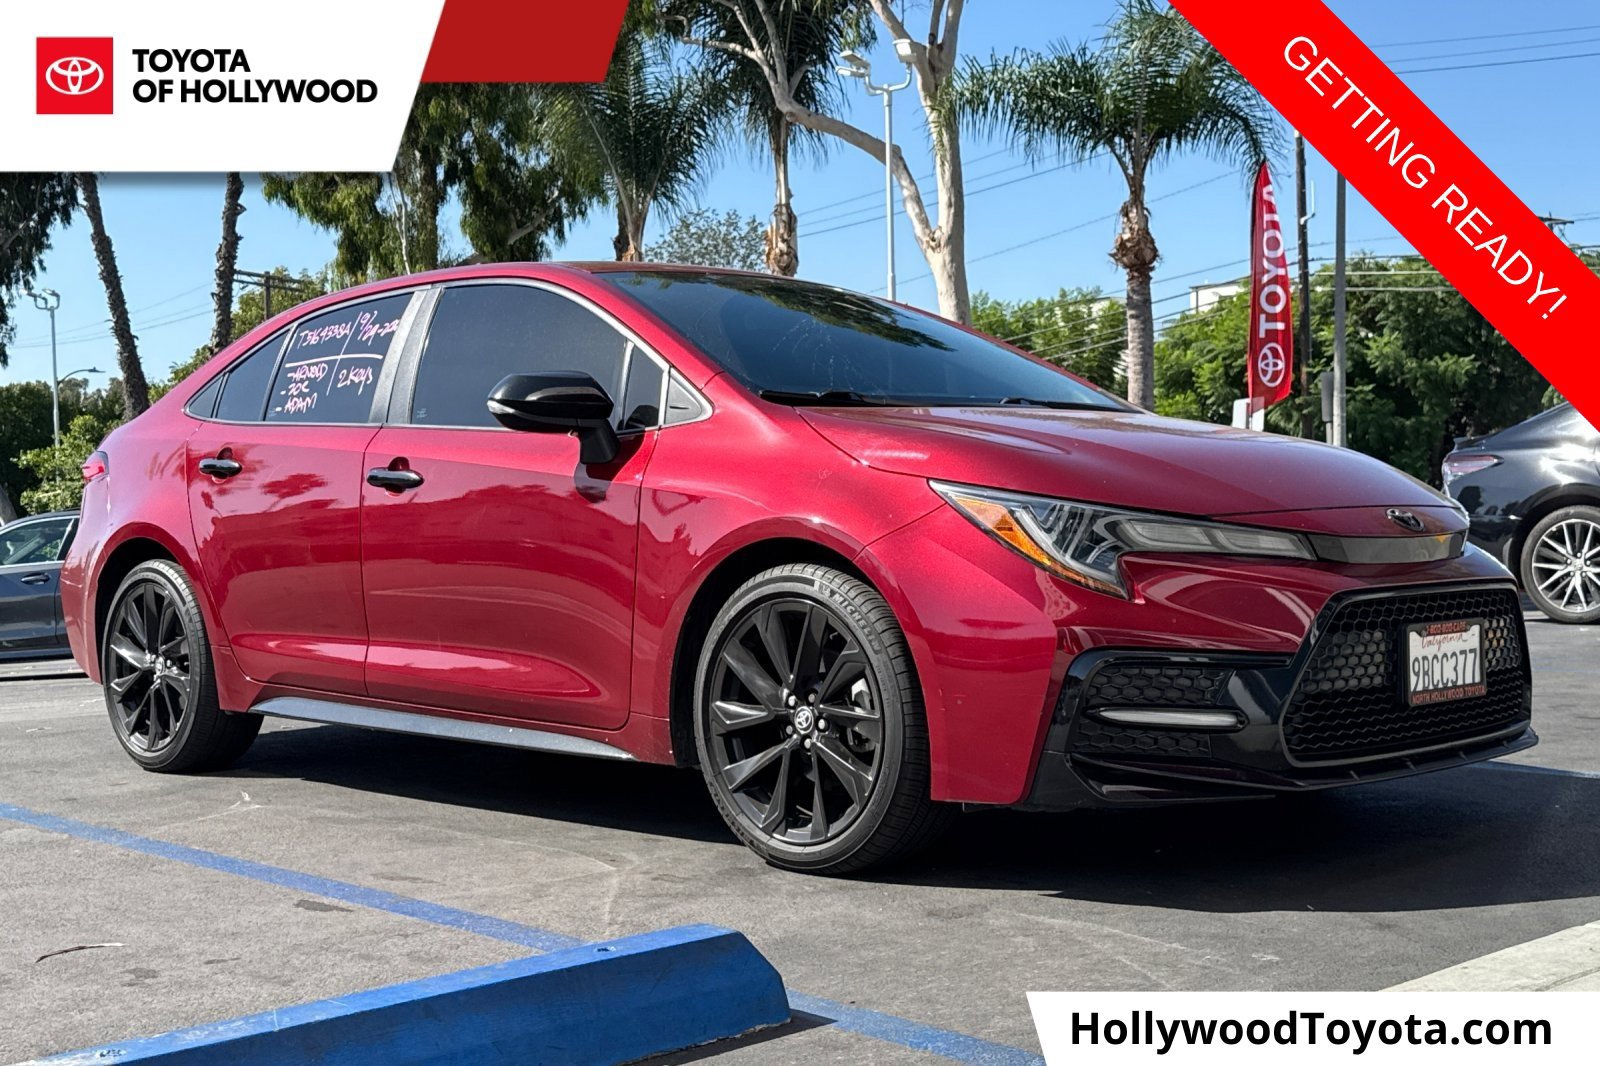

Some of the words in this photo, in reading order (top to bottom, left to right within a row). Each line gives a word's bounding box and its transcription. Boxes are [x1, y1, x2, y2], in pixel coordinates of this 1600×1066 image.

[1259, 184, 1287, 339] TOYOTA
[832, 593, 881, 652] MICHELIN
[1412, 648, 1477, 692] 9BCC377
[1412, 693, 1430, 704] NORTH
[1431, 687, 1464, 702] HOLLYWOOD
[1464, 685, 1485, 697] TOYOTA
